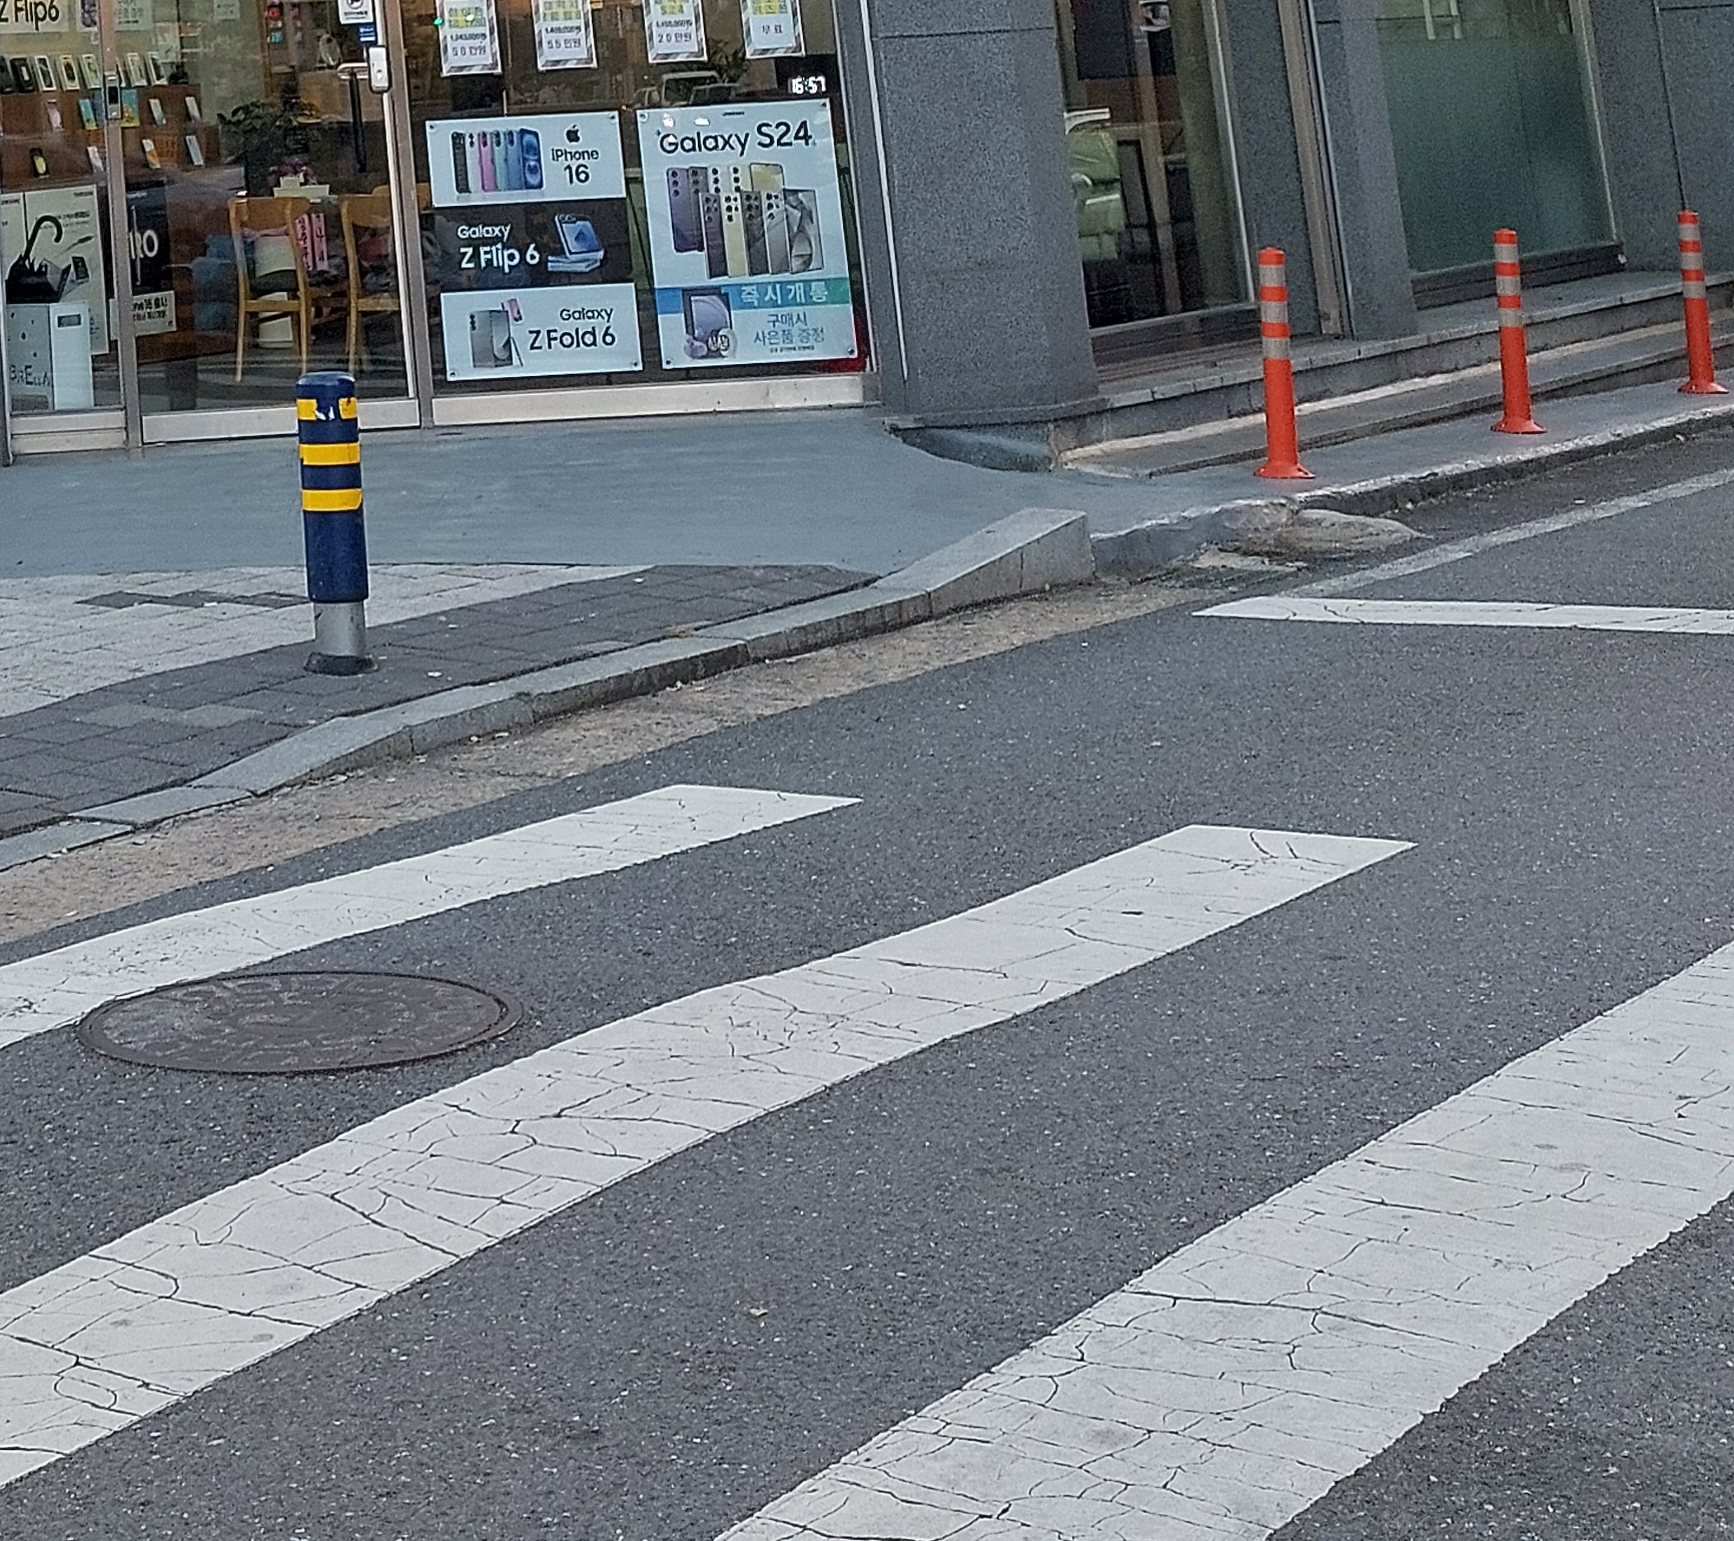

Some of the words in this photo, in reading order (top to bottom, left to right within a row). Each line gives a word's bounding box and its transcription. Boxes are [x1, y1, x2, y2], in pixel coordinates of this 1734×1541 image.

[658, 130, 750, 158] Galaxy
[755, 120, 812, 149] S24
[551, 146, 600, 164] iPhone
[564, 163, 590, 186] 16
[457, 222, 511, 243] Galaxy
[459, 246, 474, 270] Z
[480, 243, 520, 274] Flip
[525, 243, 541, 267] 6
[559, 306, 614, 324] Galaxy
[528, 329, 544, 352] Z
[546, 326, 598, 350] Fold
[601, 326, 616, 347] 6
